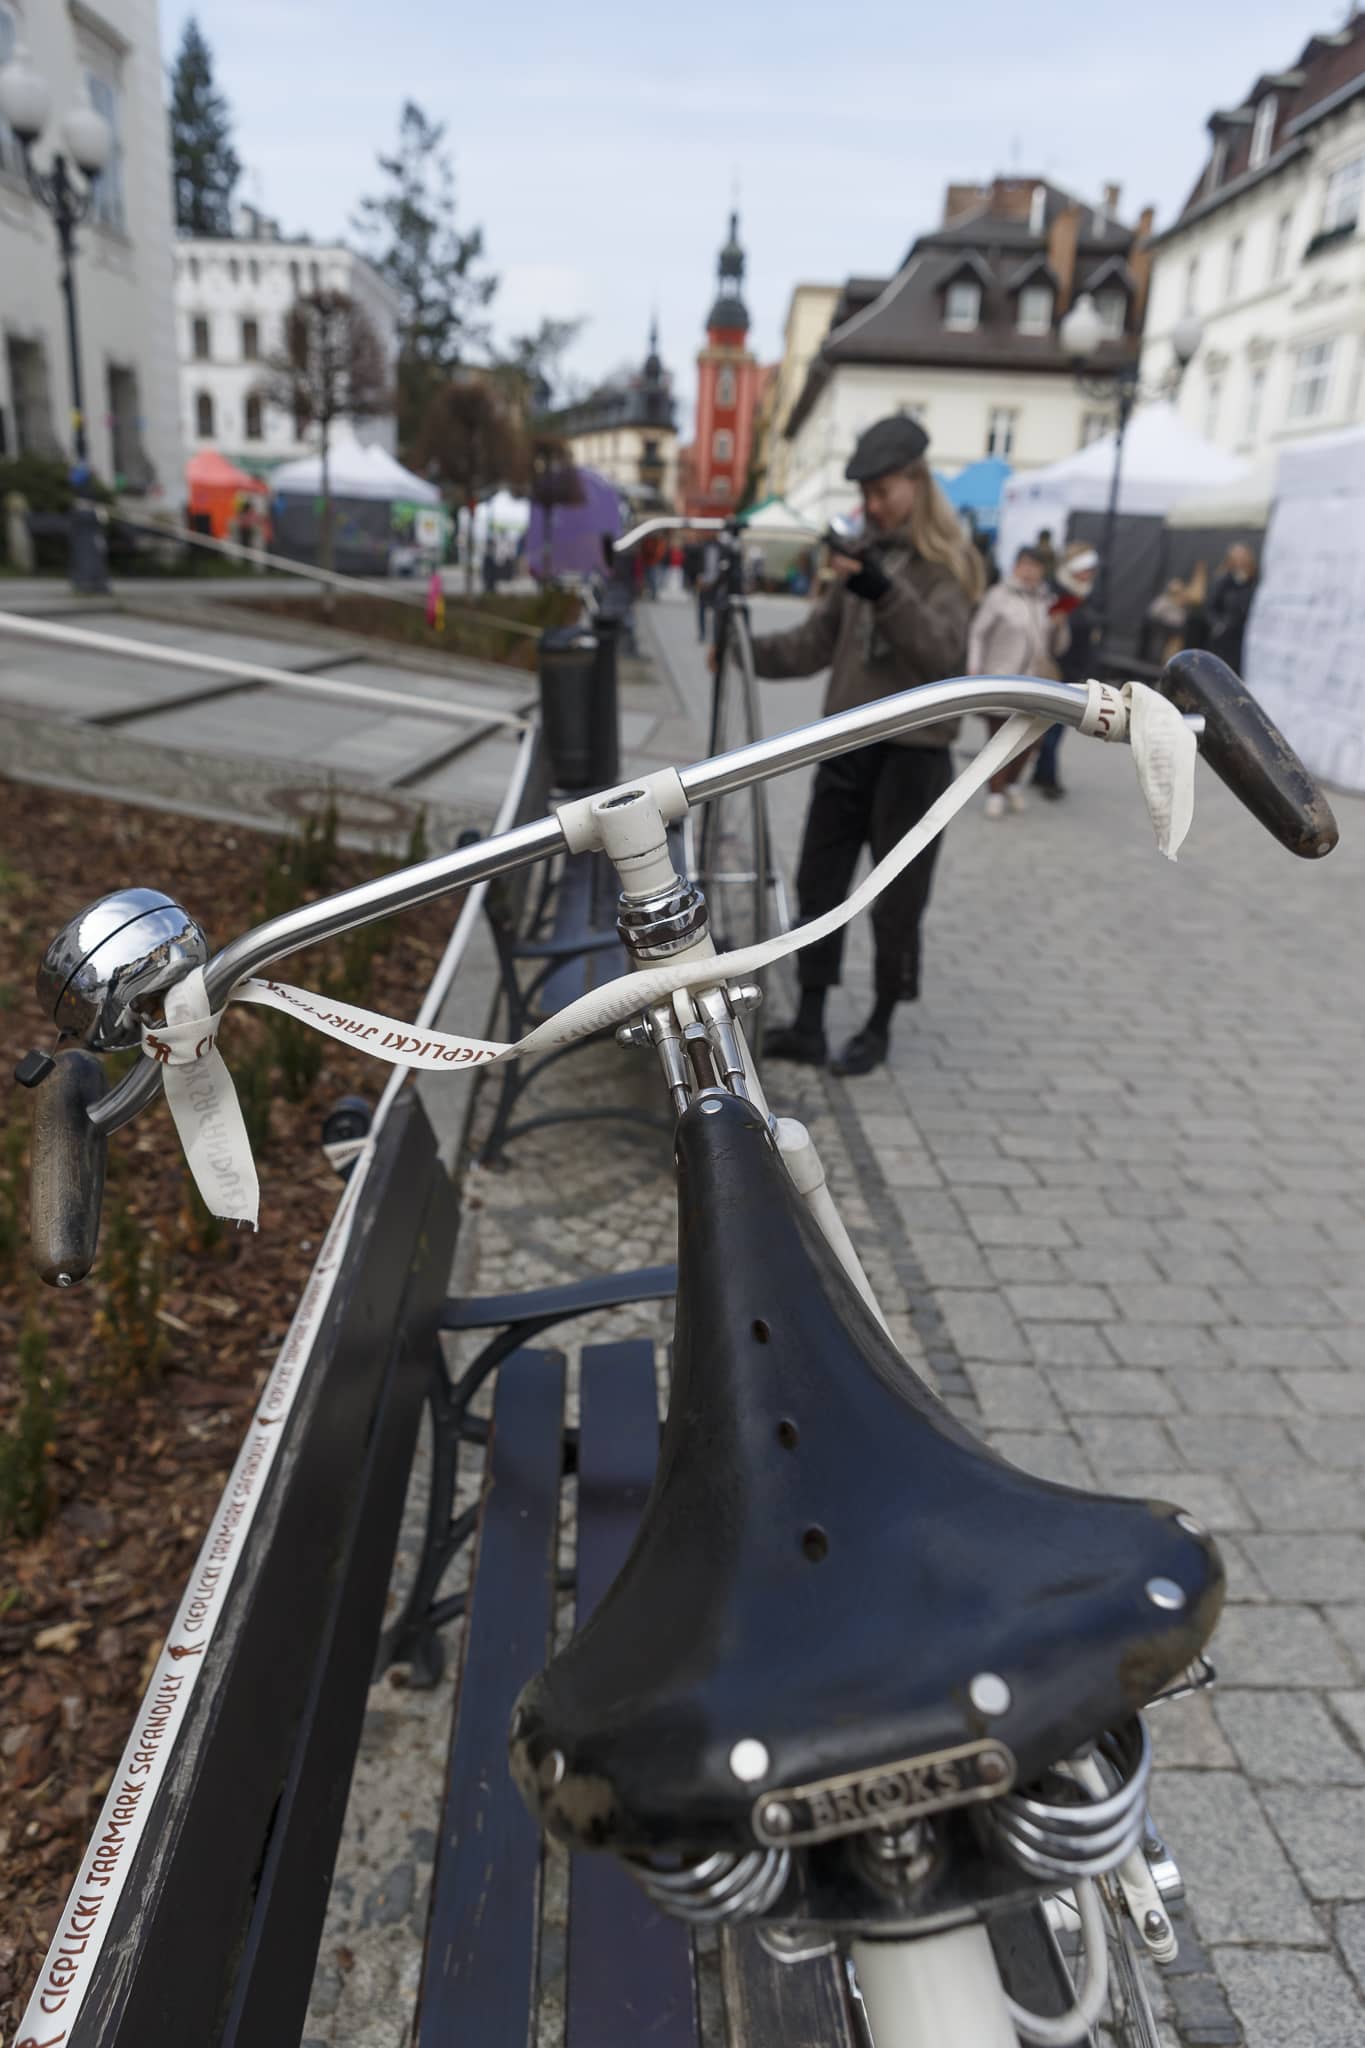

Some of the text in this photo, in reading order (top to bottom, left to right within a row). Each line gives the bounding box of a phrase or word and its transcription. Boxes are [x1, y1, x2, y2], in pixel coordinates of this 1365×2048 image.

[183, 1565, 223, 1632] CIEPLICKI
[807, 1763, 961, 1822] BROOKS
[40, 1673, 184, 2014] CIEPLICKI JARMARK SAFANDUŁY
